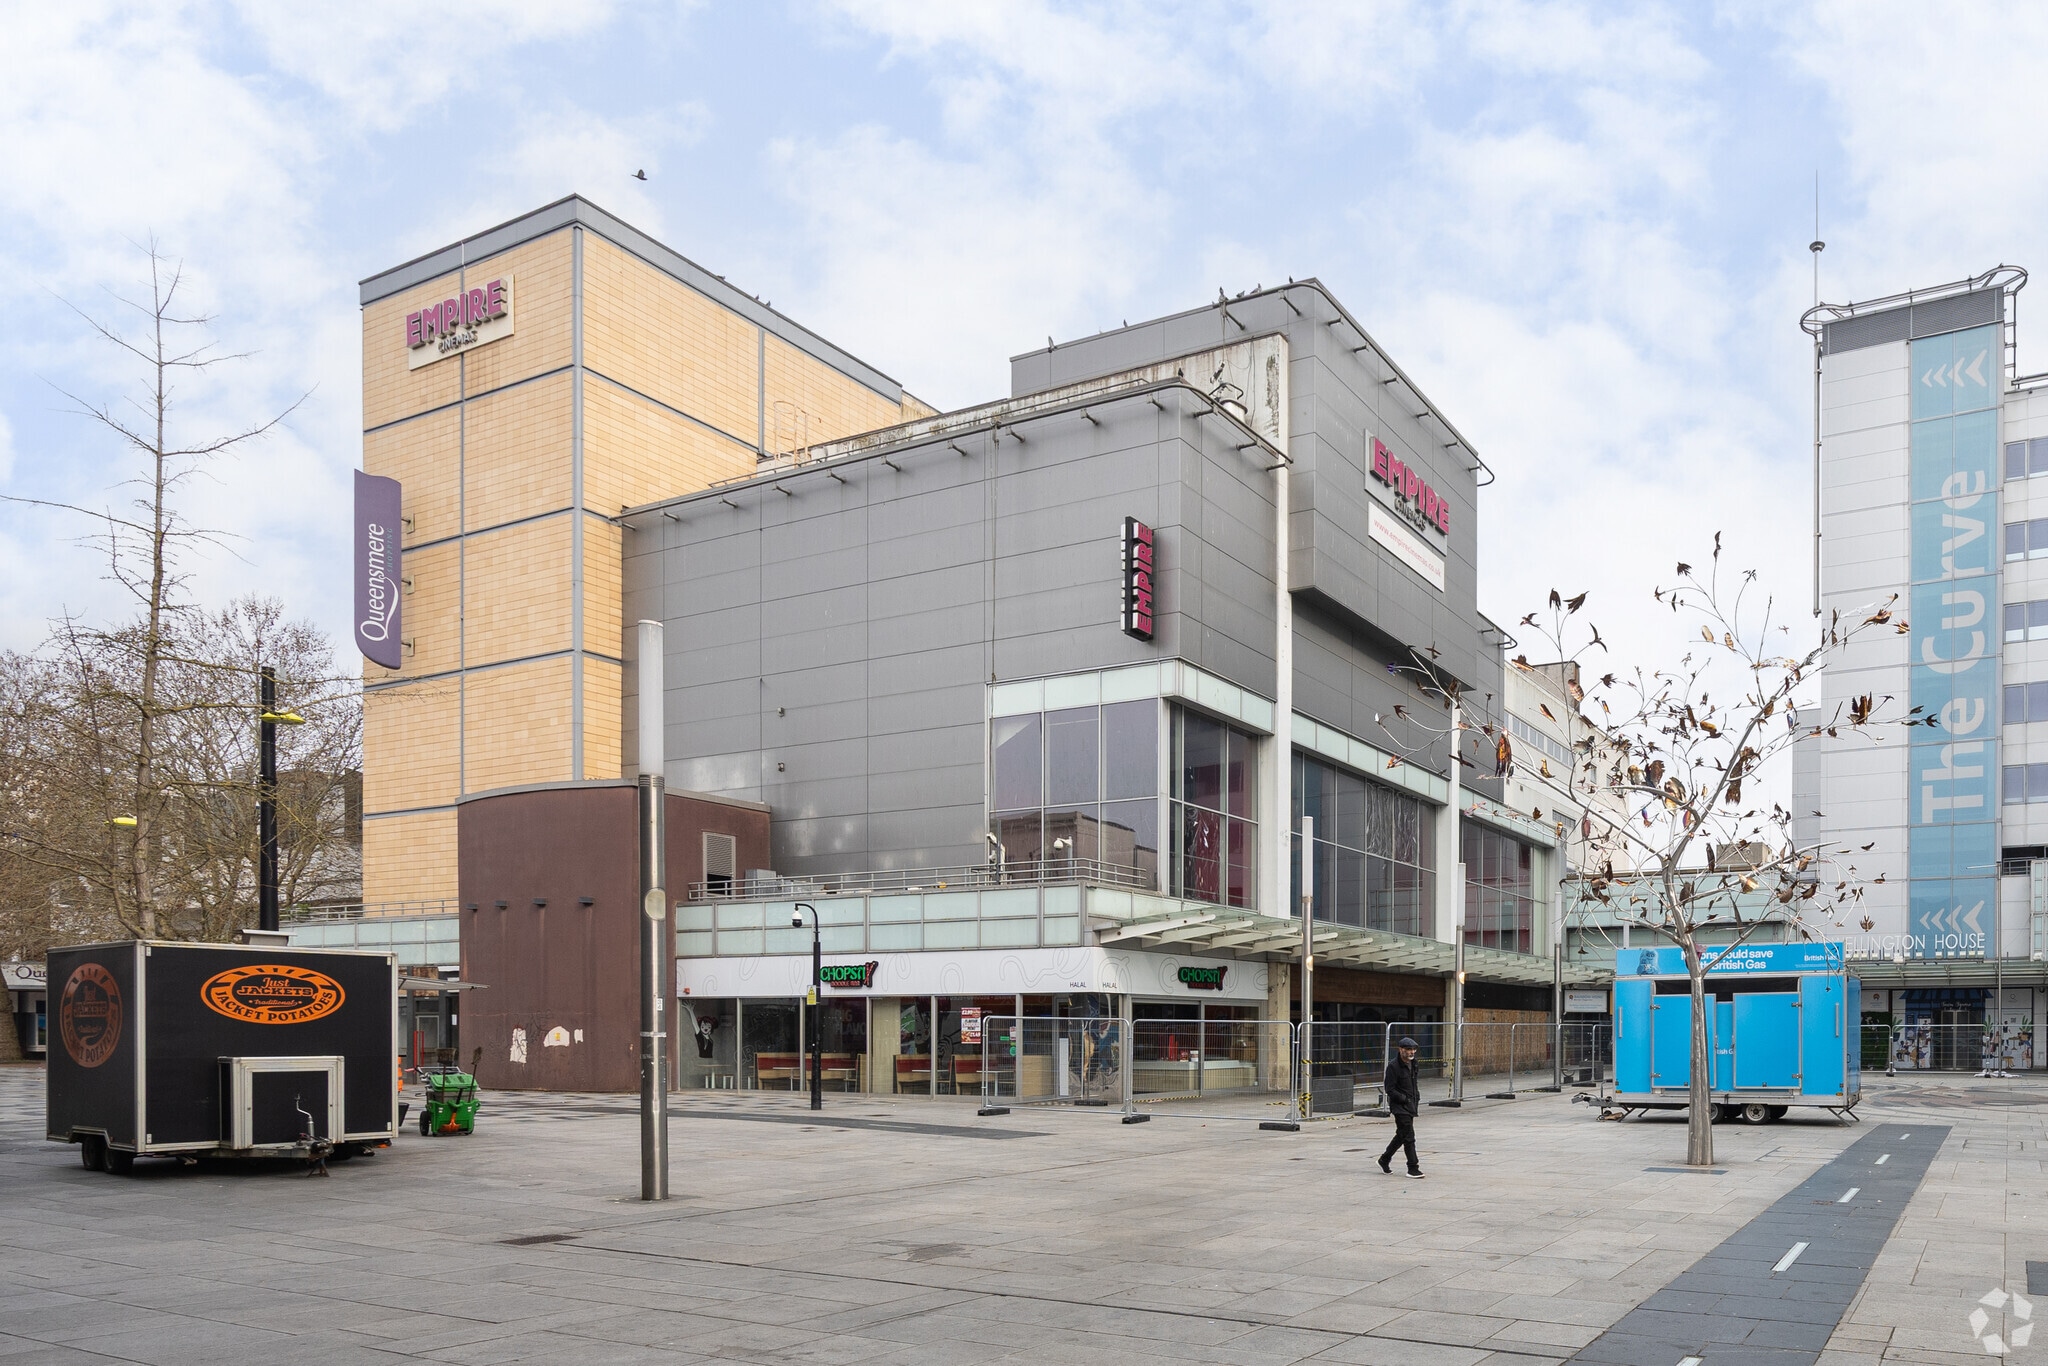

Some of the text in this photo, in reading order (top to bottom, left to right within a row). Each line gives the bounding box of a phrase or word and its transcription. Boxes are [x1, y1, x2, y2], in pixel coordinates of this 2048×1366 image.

[406, 279, 507, 350] EMPIRE
[438, 330, 478, 353] CINEMAS
[1369, 436, 1450, 536] EMPIRE
[1394, 498, 1427, 533] CINEMAS
[1373, 518, 1442, 577] www.empirecinemas.co.uk
[360, 523, 399, 642] Queensmere
[1133, 522, 1153, 635] EMPIRE
[1921, 470, 1986, 824] The Curve
[1748, 950, 1773, 959] save
[1935, 933, 1986, 950] HOUSE
[1745, 960, 1766, 970] Gas
[237, 986, 315, 997] JACKETS
[263, 977, 290, 988] Just
[215, 991, 333, 1021] JACKET POTATOES
[252, 999, 298, 1007] traditional
